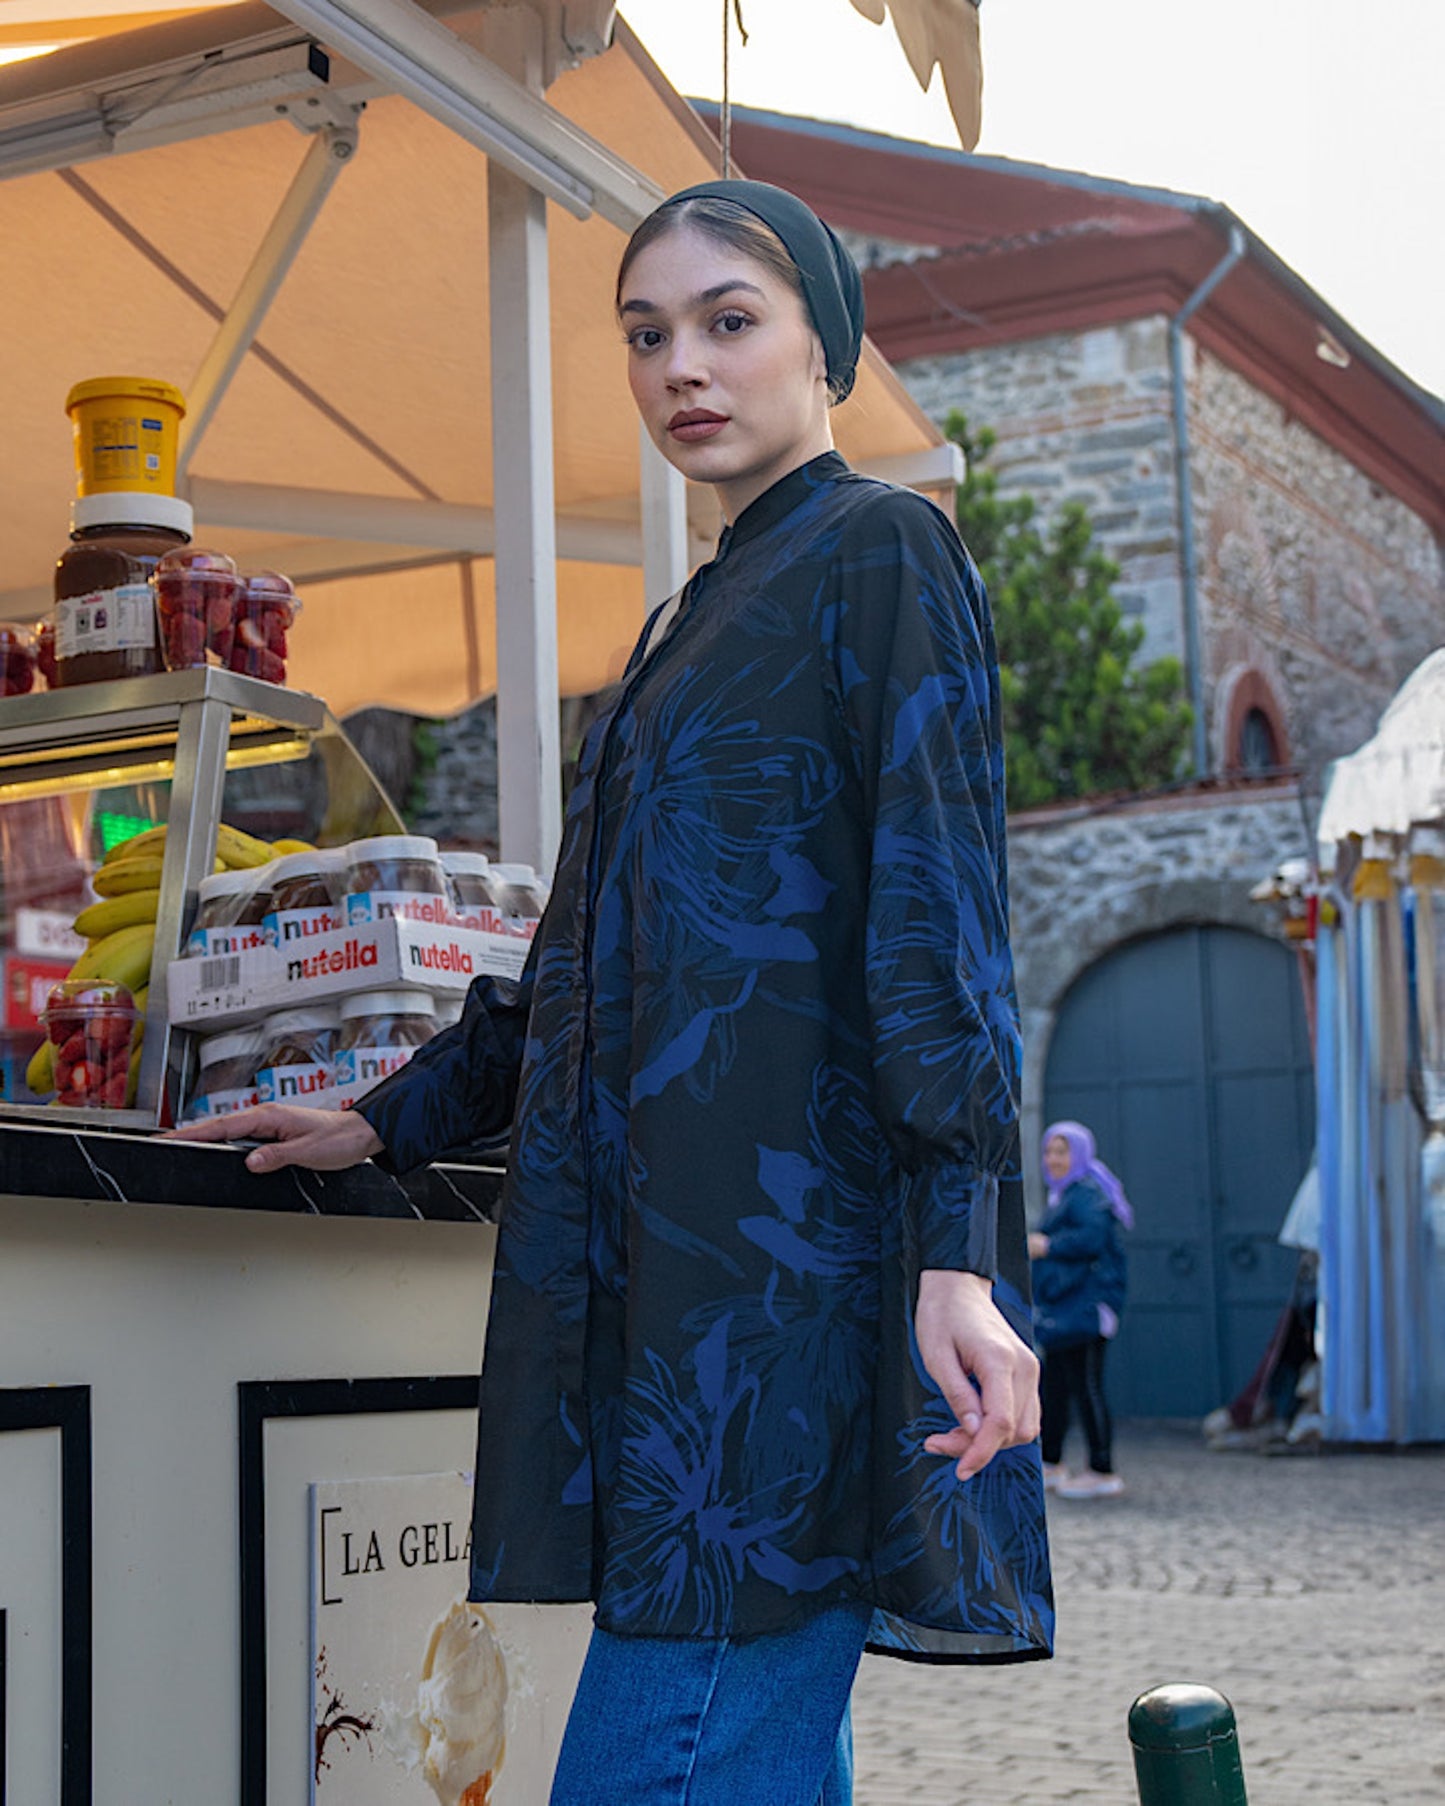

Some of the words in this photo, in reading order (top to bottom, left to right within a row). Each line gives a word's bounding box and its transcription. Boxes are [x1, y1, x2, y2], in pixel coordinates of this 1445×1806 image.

[213, 931, 265, 955] nut
[410, 942, 474, 975] nutella
[288, 939, 378, 981] nutella
[280, 1069, 335, 1096] nut
[341, 1530, 386, 1576] LA
